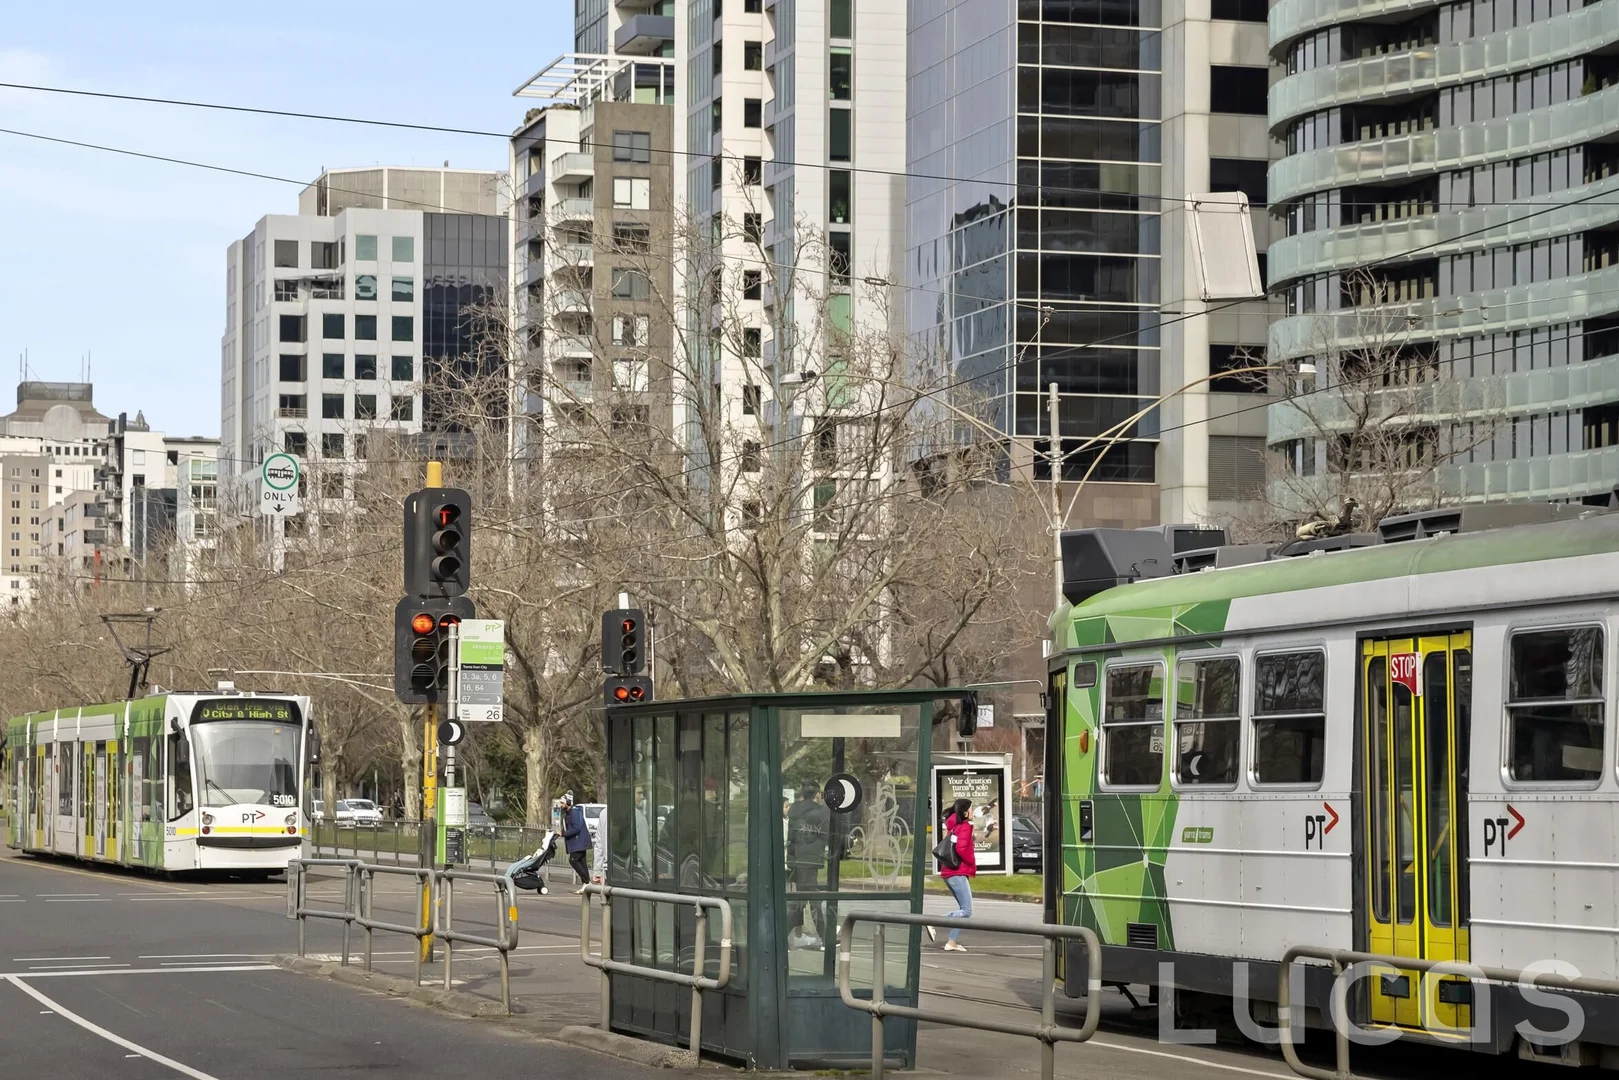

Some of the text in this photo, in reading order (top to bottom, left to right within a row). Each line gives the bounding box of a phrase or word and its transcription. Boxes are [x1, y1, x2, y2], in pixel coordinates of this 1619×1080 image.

[264, 492, 294, 502] ONLY
[1392, 656, 1415, 678] STOP
[212, 710, 232, 718] City
[249, 710, 272, 718] High
[486, 710, 500, 720] 26
[274, 795, 294, 805] 5010
[166, 826, 176, 836] 5010
[1184, 830, 1212, 840] yarra trams
[974, 840, 992, 849] today
